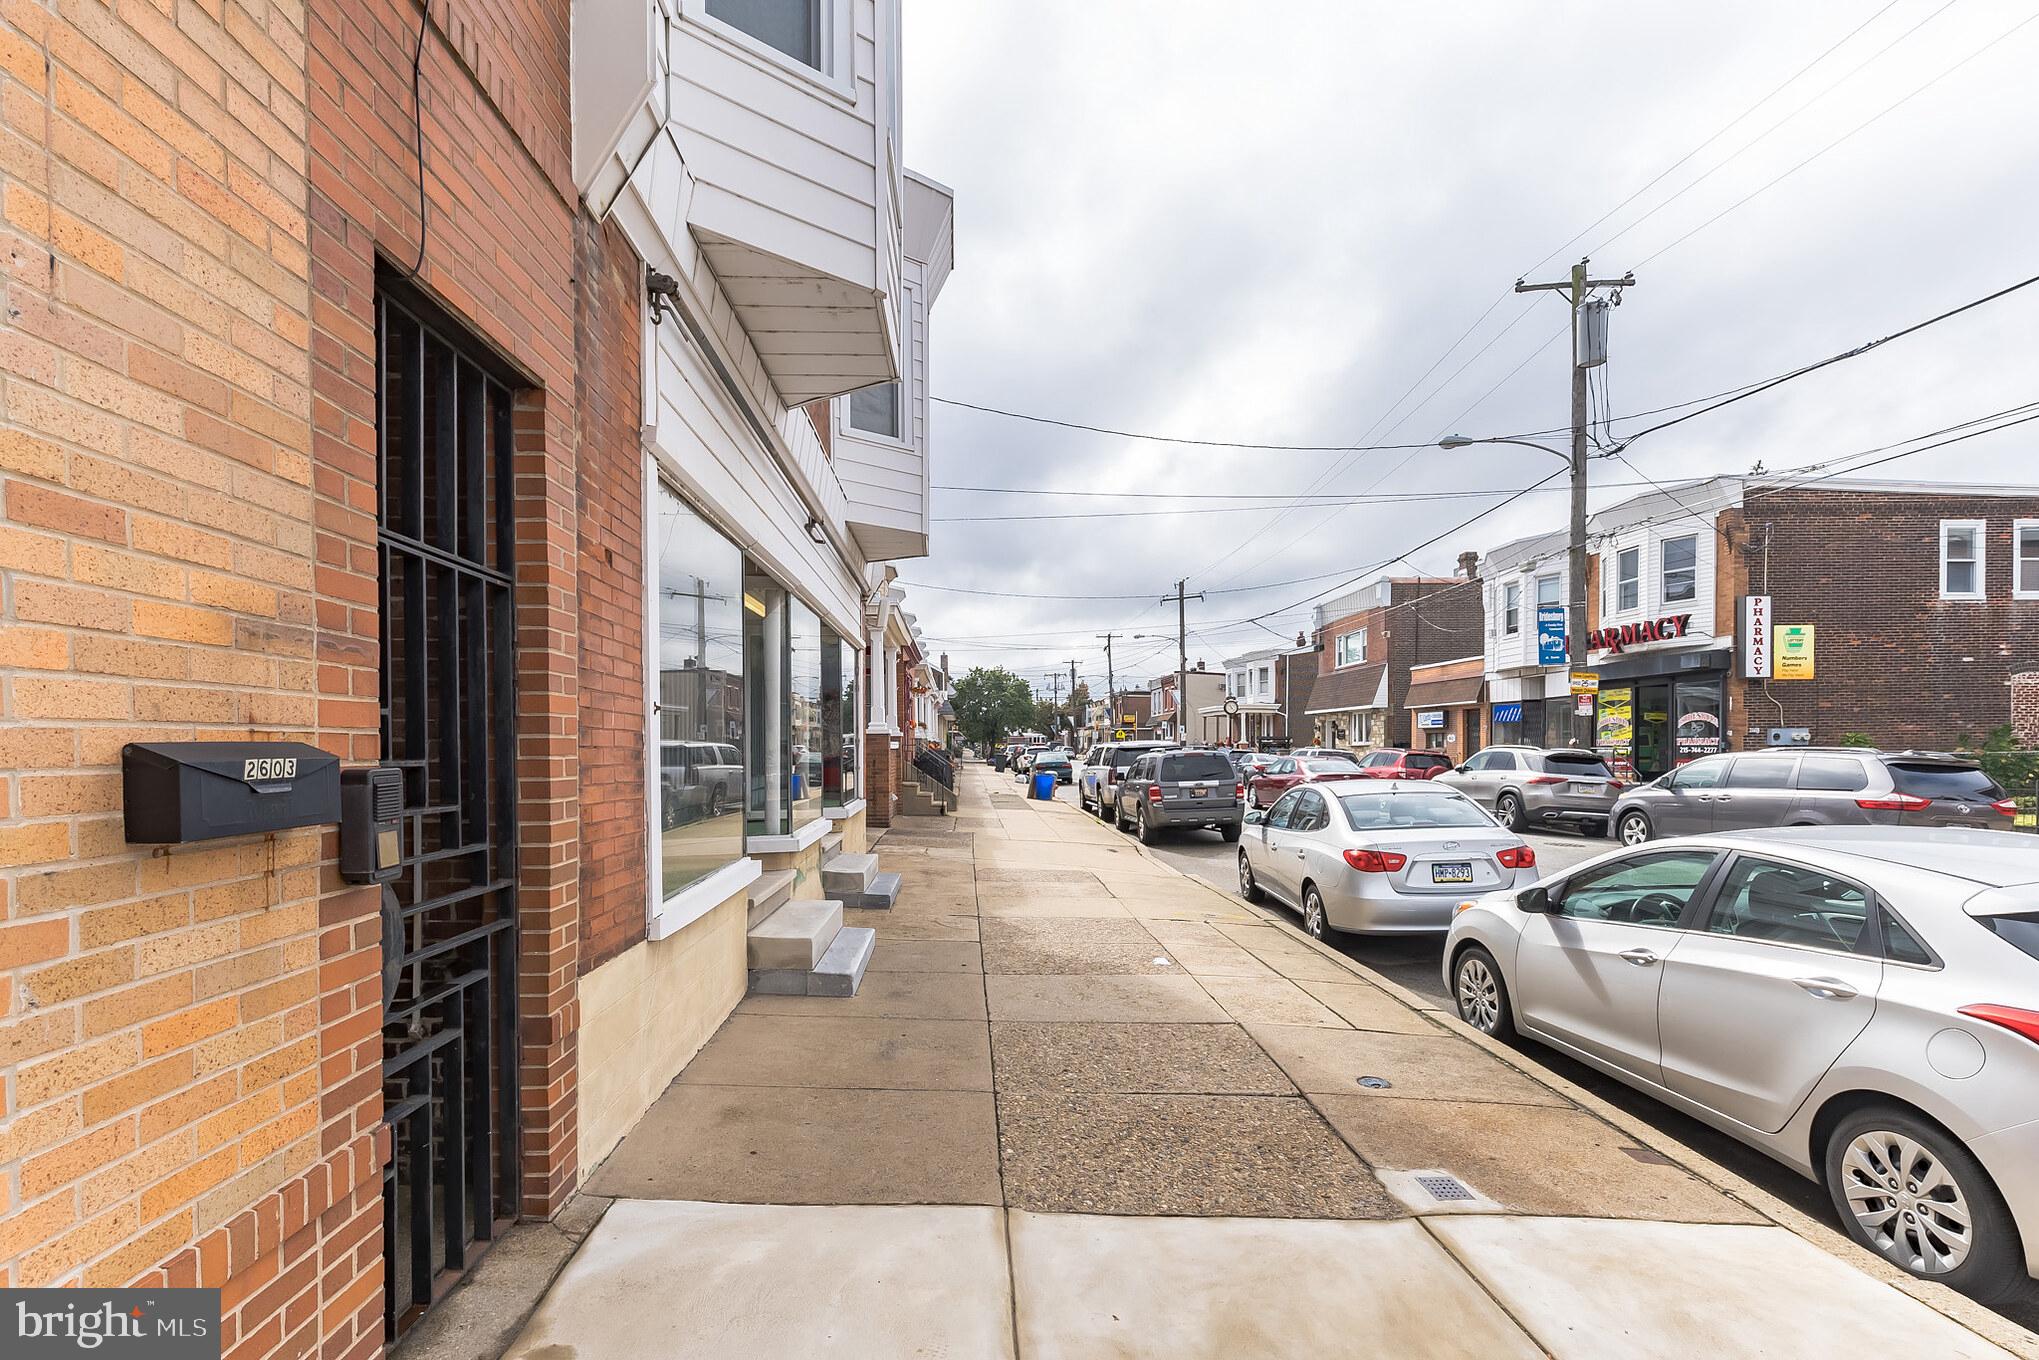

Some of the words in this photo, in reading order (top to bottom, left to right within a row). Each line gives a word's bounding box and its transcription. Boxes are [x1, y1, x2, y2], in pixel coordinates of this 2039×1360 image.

[1565, 614, 1692, 654] ARMACY
[1753, 598, 1764, 675] PHARMACY
[1677, 738, 1720, 746] PHARMACY
[246, 760, 295, 778] 2603
